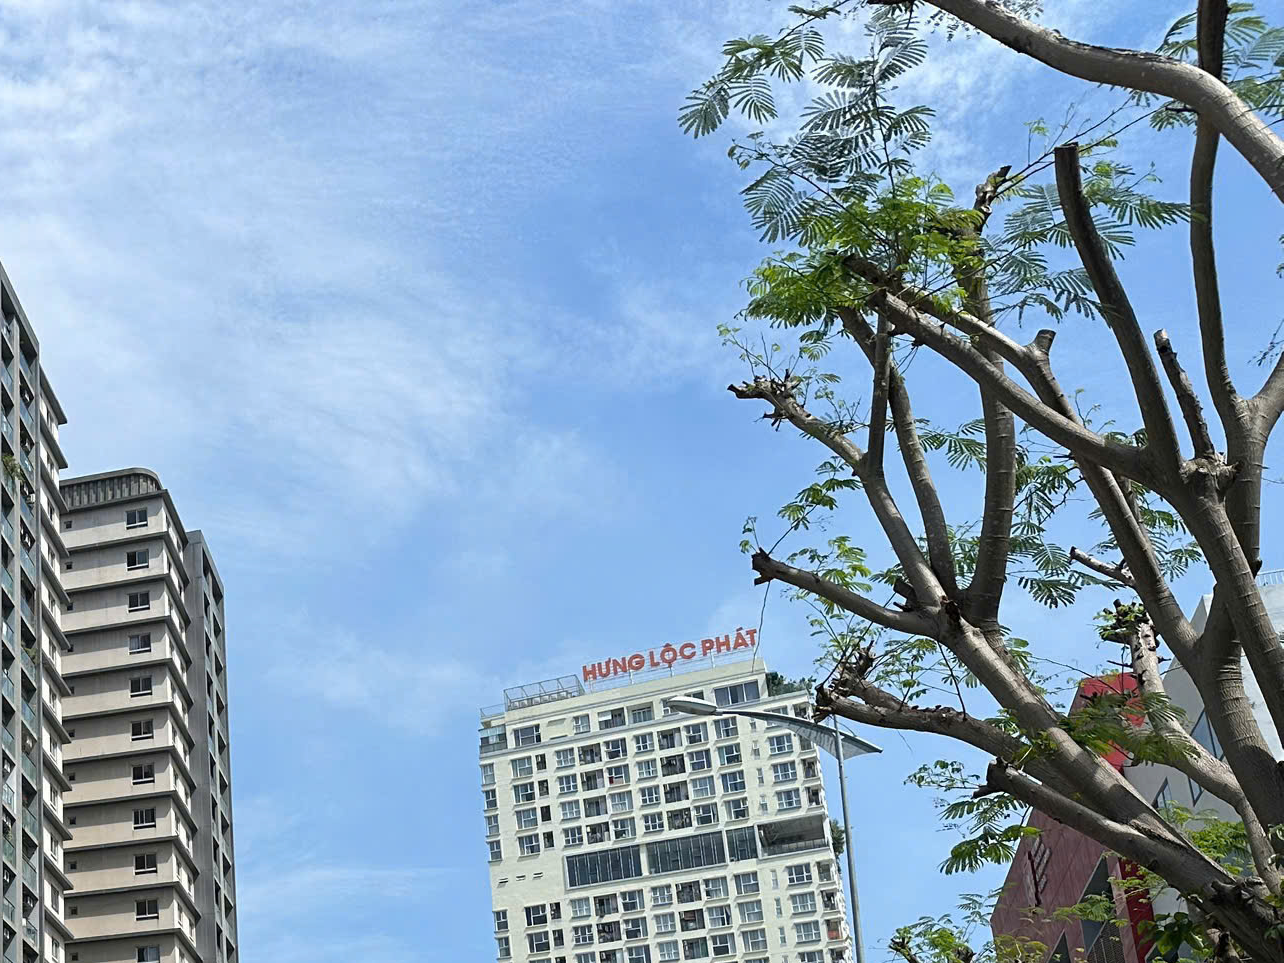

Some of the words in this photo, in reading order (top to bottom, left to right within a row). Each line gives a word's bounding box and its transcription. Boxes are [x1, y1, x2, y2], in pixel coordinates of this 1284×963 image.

[582, 654, 645, 682] HƯNG
[649, 643, 696, 668] LỘC
[701, 627, 757, 656] PHÁT
